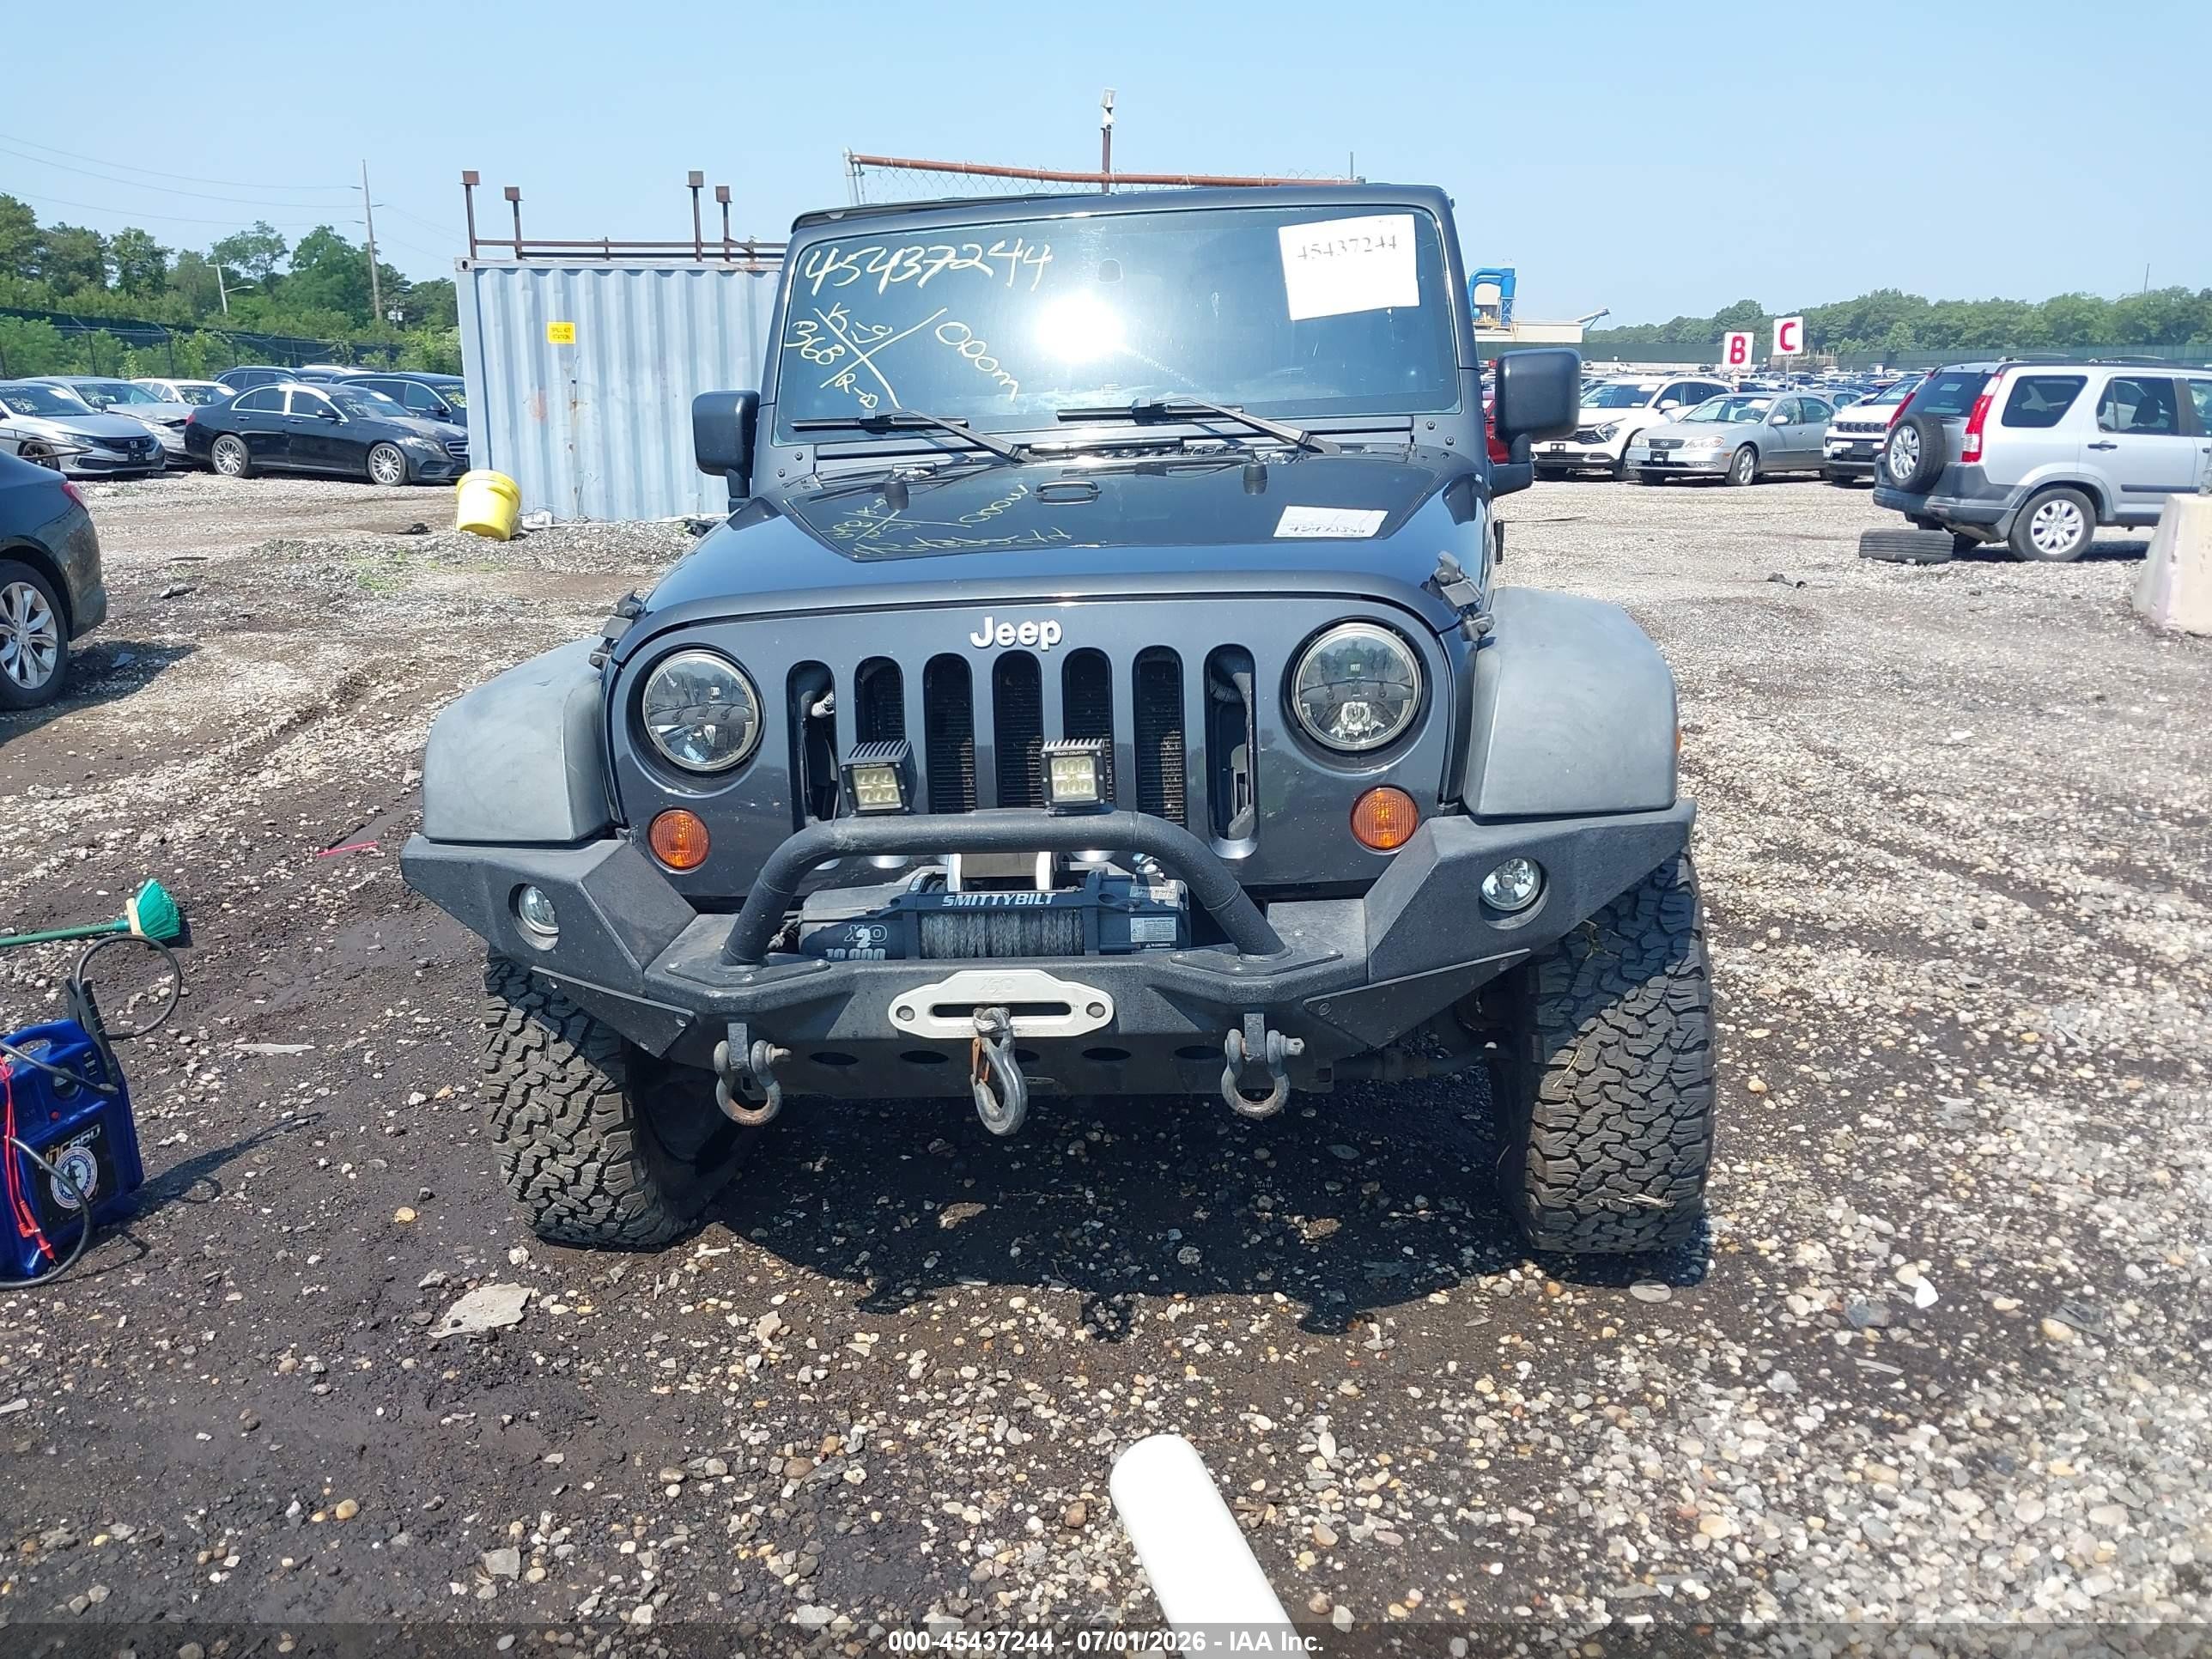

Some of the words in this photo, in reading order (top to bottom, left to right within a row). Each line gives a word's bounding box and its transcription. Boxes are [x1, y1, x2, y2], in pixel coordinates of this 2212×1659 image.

[1297, 234, 1397, 260] 45437244
[805, 237, 1054, 297] 45437244
[1729, 336, 1747, 364] B
[1780, 321, 1796, 351] C
[969, 616, 1063, 652] Jeep
[942, 892, 1056, 907] SMITTYBILT
